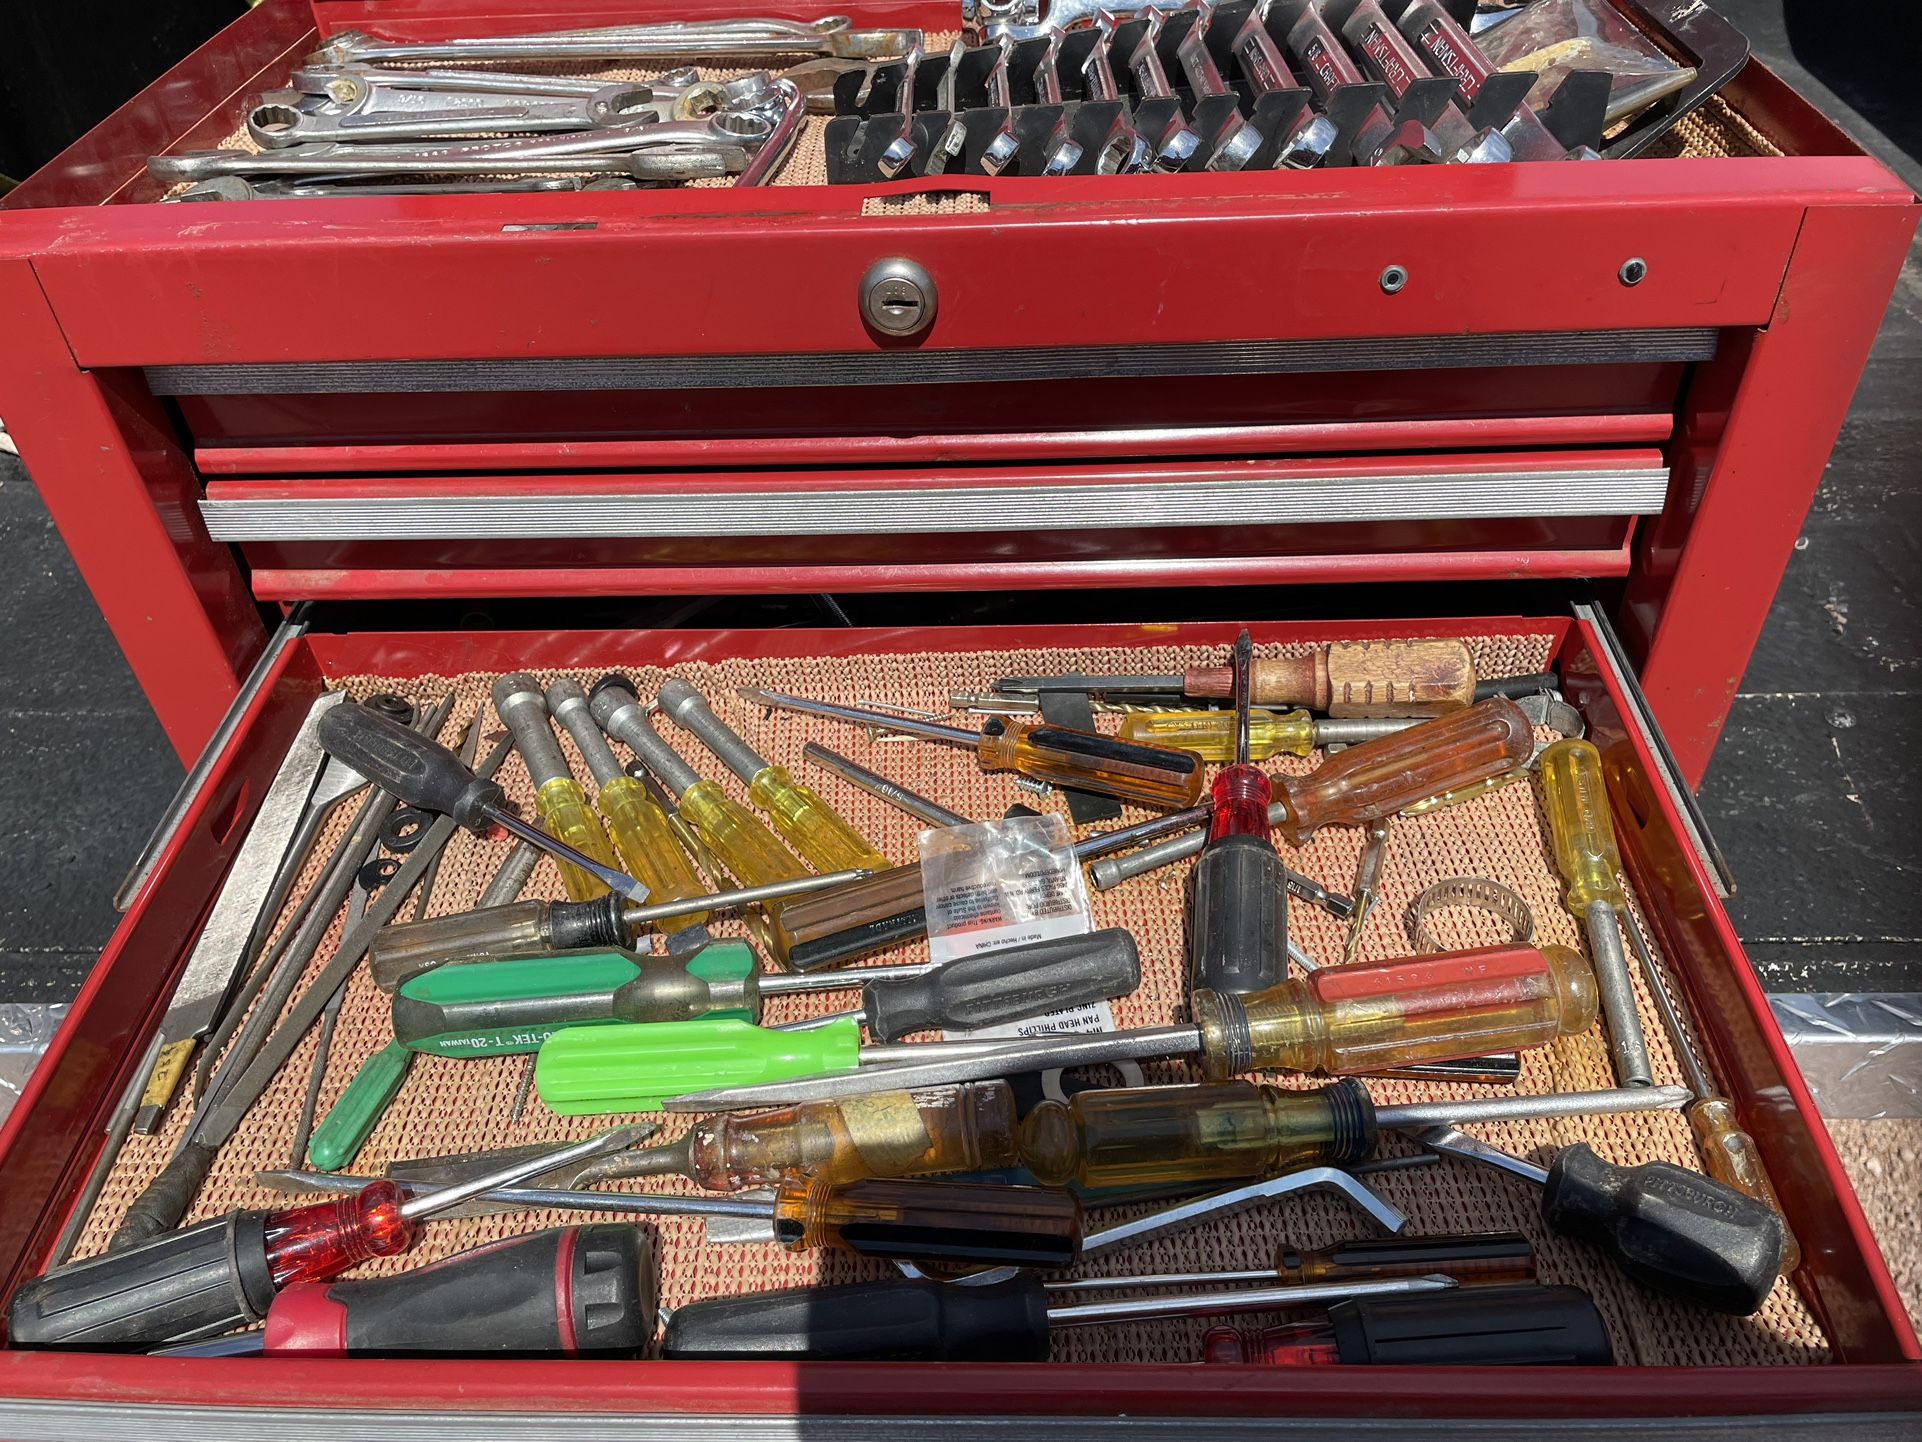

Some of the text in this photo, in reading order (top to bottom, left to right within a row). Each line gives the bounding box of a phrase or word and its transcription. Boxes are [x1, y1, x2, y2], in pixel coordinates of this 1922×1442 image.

[1363, 28, 1406, 84] CRAFTSMAN
[1431, 35, 1476, 92] CRAFTSMAN
[439, 1037, 471, 1047] TAIWAN
[1017, 1014, 1100, 1037] PAN HEAD PHILLIPS
[1643, 1174, 1740, 1219] PITTSBURGH
